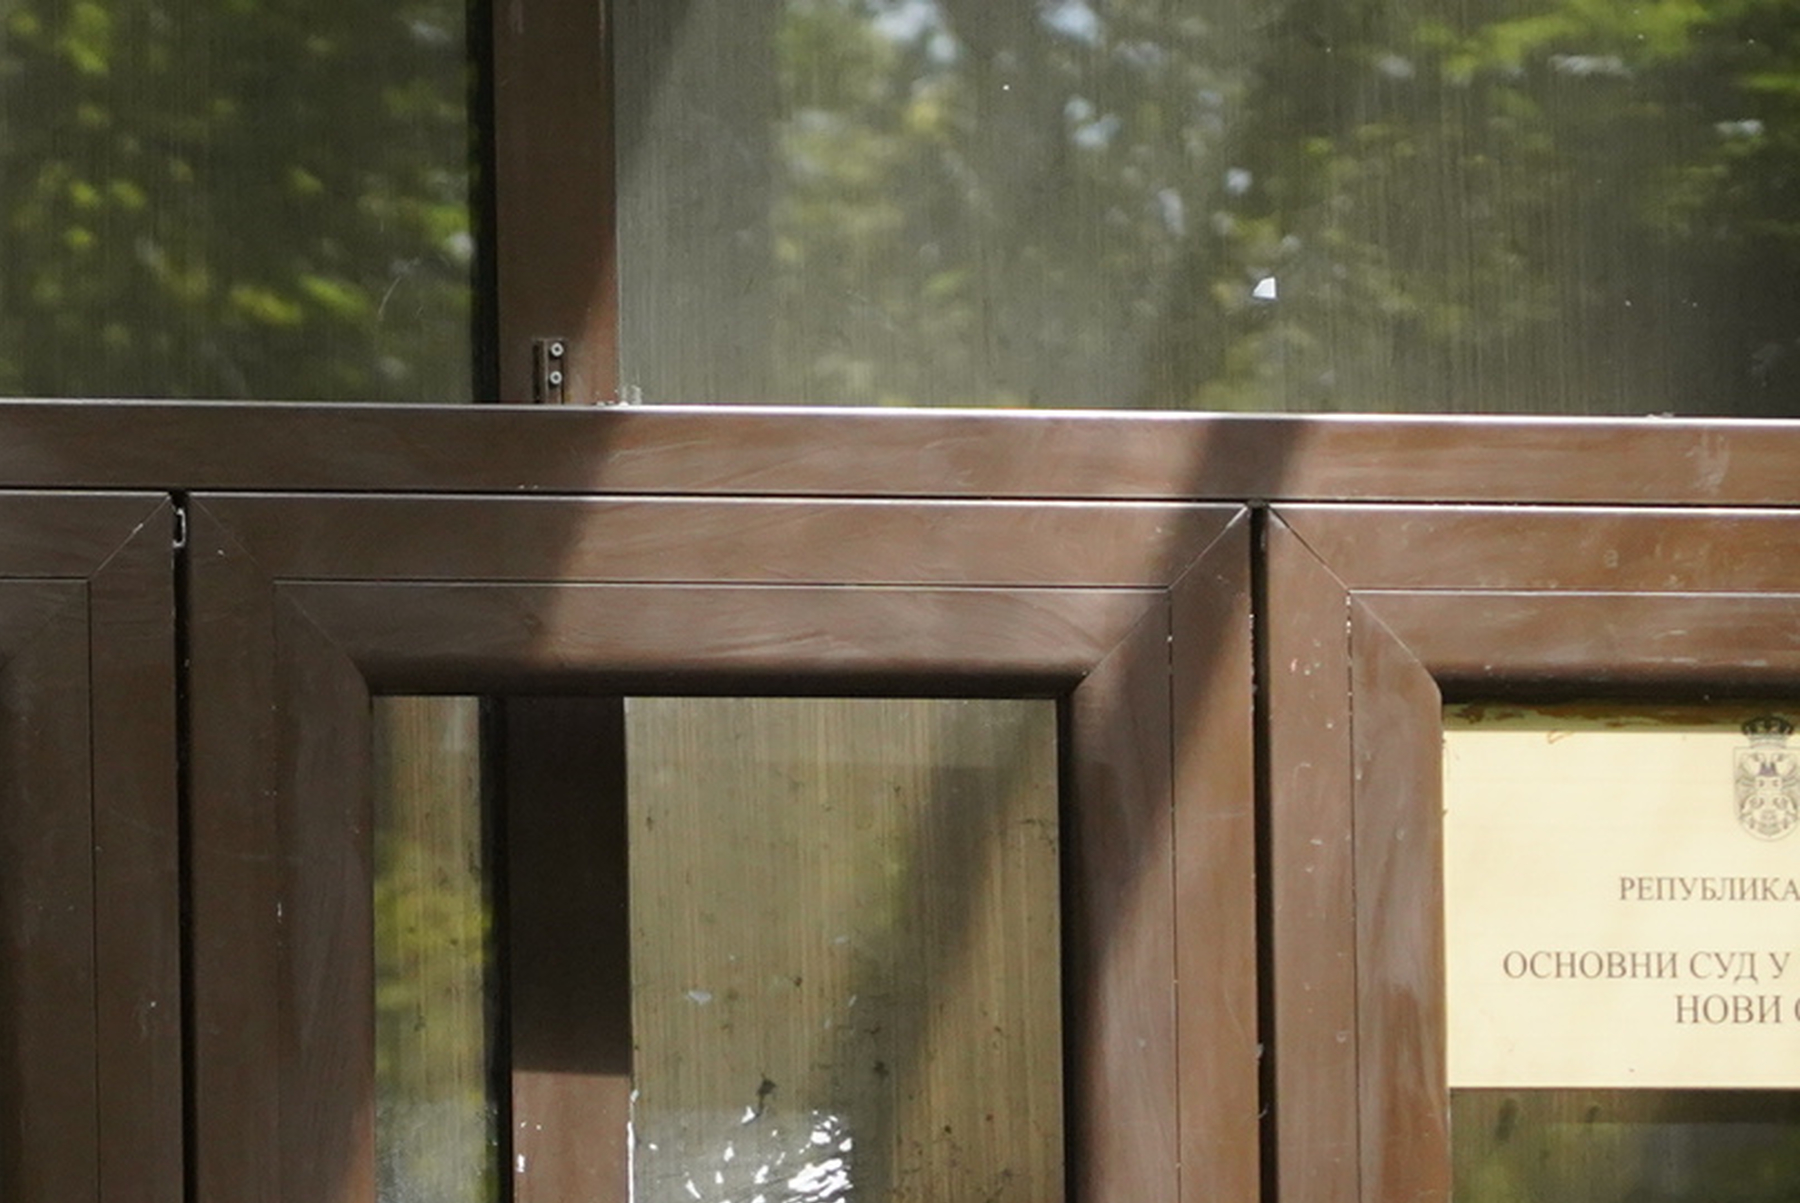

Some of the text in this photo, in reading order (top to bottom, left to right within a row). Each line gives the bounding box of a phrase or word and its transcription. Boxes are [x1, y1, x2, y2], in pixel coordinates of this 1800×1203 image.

[1619, 875, 1800, 902] РЕПУБЛИКА
[1502, 950, 1791, 985] ОСНОВНИ СУД У
[1675, 993, 1783, 1025] НОВИ
